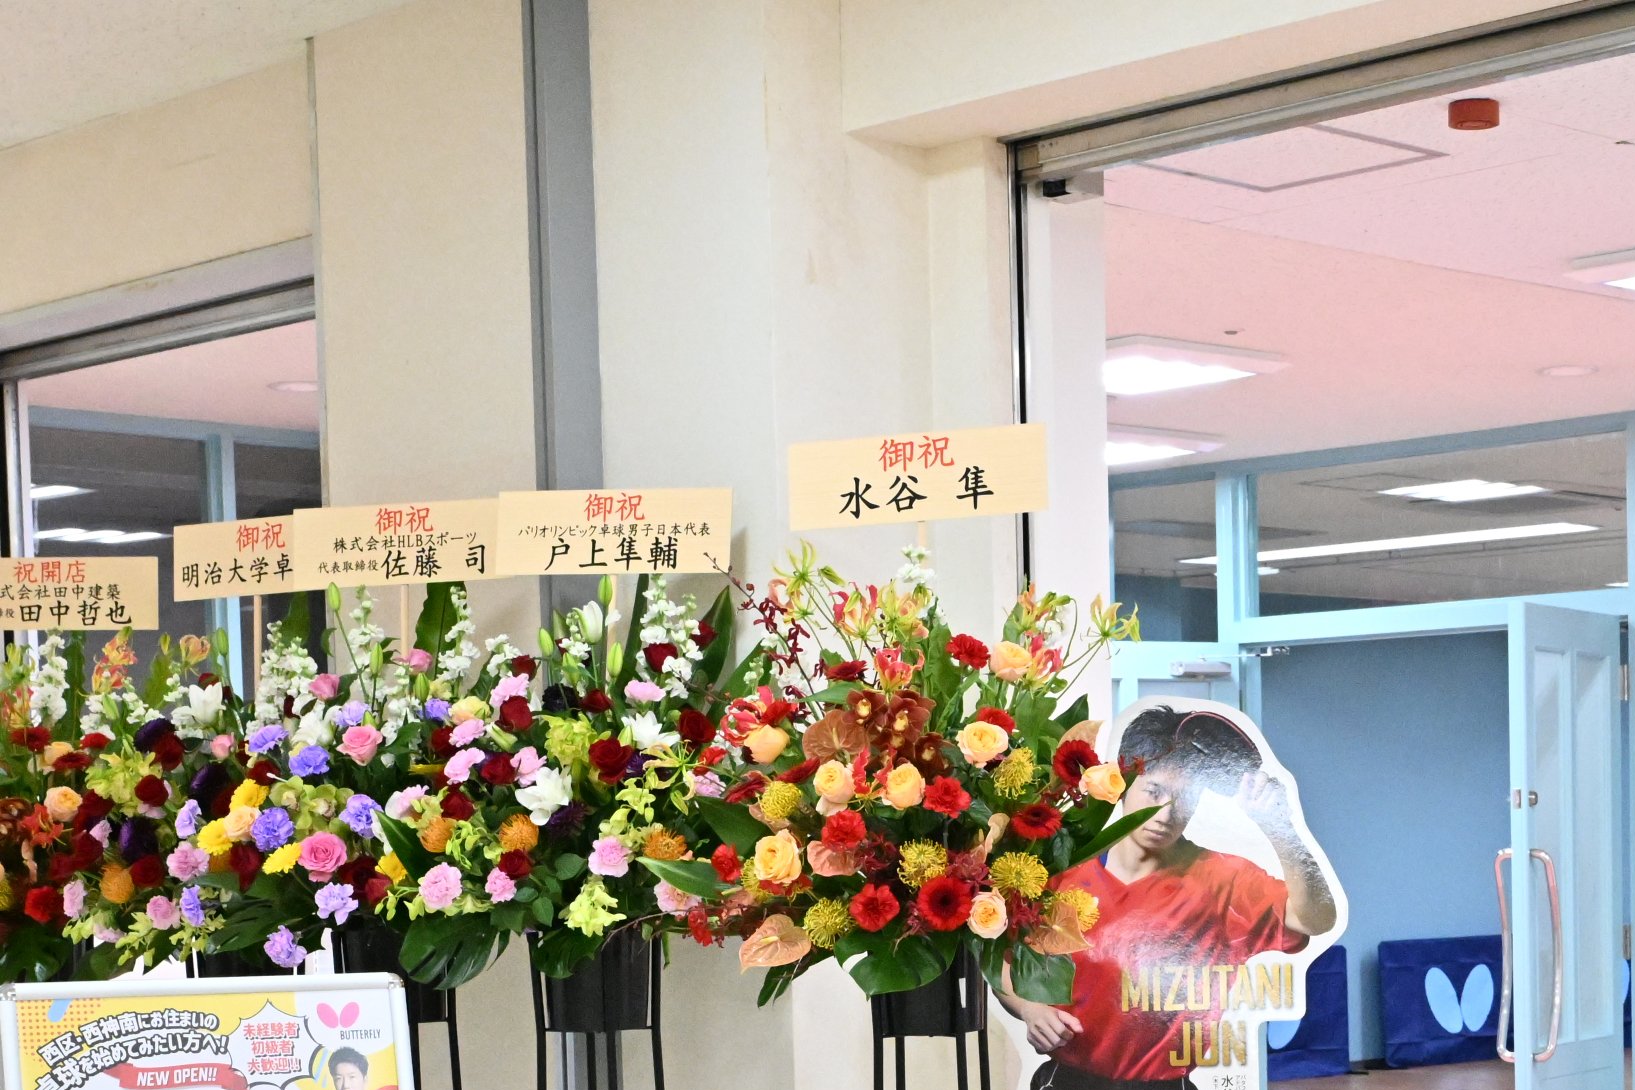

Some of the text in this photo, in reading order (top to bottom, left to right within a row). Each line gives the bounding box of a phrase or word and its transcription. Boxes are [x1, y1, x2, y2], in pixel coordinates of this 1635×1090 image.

[878, 436, 955, 473] 御祝
[584, 493, 646, 522] 御祝
[838, 466, 995, 520] 水谷 隼
[375, 506, 434, 535] 御祝
[518, 522, 711, 538] パリオリンピック卓球男子日本代表
[236, 523, 286, 553] 御祝
[333, 531, 477, 553] 株式会社HLBスポーツ
[318, 544, 486, 579] 代表取締役 佐藤 司
[544, 537, 678, 571] 戸上隼輔
[14, 560, 86, 584] 祝開店
[182, 553, 293, 588] 明治大学卓
[20, 600, 132, 626] 田中哲也
[1121, 963, 1294, 1013] MIZUTANI
[243, 1022, 300, 1039] 未経験者
[340, 1029, 381, 1040] BUTTERFLY
[1169, 1020, 1247, 1068] JUN
[251, 1040, 295, 1057] 初級者
[137, 1068, 217, 1087] NEW OPEN!!
